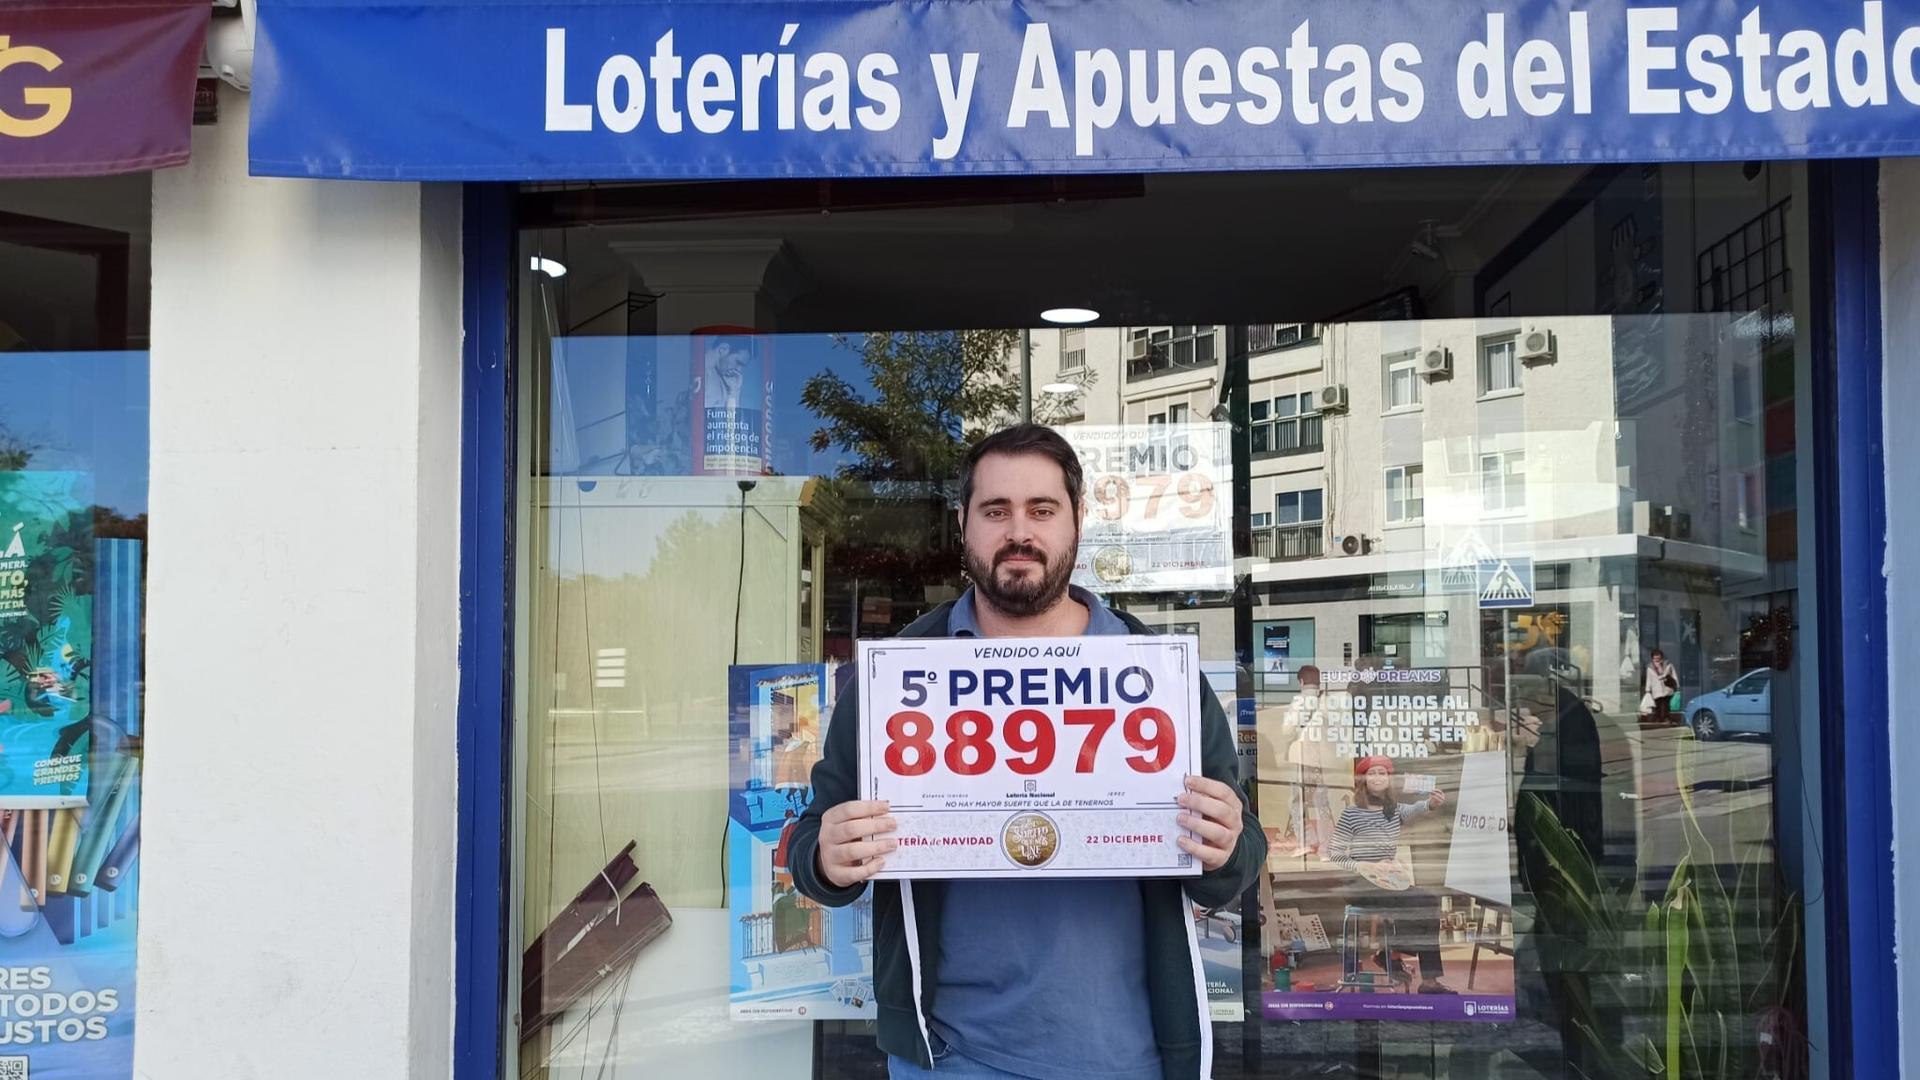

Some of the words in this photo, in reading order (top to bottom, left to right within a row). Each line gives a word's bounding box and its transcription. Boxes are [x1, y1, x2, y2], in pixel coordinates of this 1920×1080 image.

[545, 23, 902, 133] Loterías
[930, 53, 980, 160] y
[1006, 19, 1425, 156] Apuestas
[1456, 10, 1592, 118] del
[706, 409, 736, 419] Fumar
[707, 421, 749, 431] aumenta
[706, 430, 715, 440] el
[717, 430, 748, 443] riesgo
[749, 432, 760, 443] de
[706, 442, 758, 455] impotencia
[1082, 473, 1214, 521] 979
[974, 646, 1039, 659] VENDIDO
[1043, 643, 1082, 658] AQUÍ
[1320, 669, 1361, 683] EURO
[1377, 669, 1441, 682] DREAMS
[900, 670, 938, 707] 5º
[949, 665, 1154, 706] PREMIO
[1372, 695, 1438, 710] EUROS
[1443, 695, 1469, 710] AL
[1284, 711, 1323, 726] MES
[1328, 711, 1381, 726] PARA
[1386, 711, 1480, 726] CUMPLIR
[884, 707, 1177, 776] 88979
[1398, 727, 1425, 742] DE
[1429, 727, 1467, 742] SER
[1336, 743, 1428, 758] PINTORA
[34, 754, 82, 768] CONSIGUE
[1460, 813, 1486, 830] EURO
[942, 837, 994, 846] NAVIDAD
[1086, 835, 1099, 844] 22
[1103, 834, 1164, 844] DICIEMBRE
[0, 988, 119, 1018] TODOS
